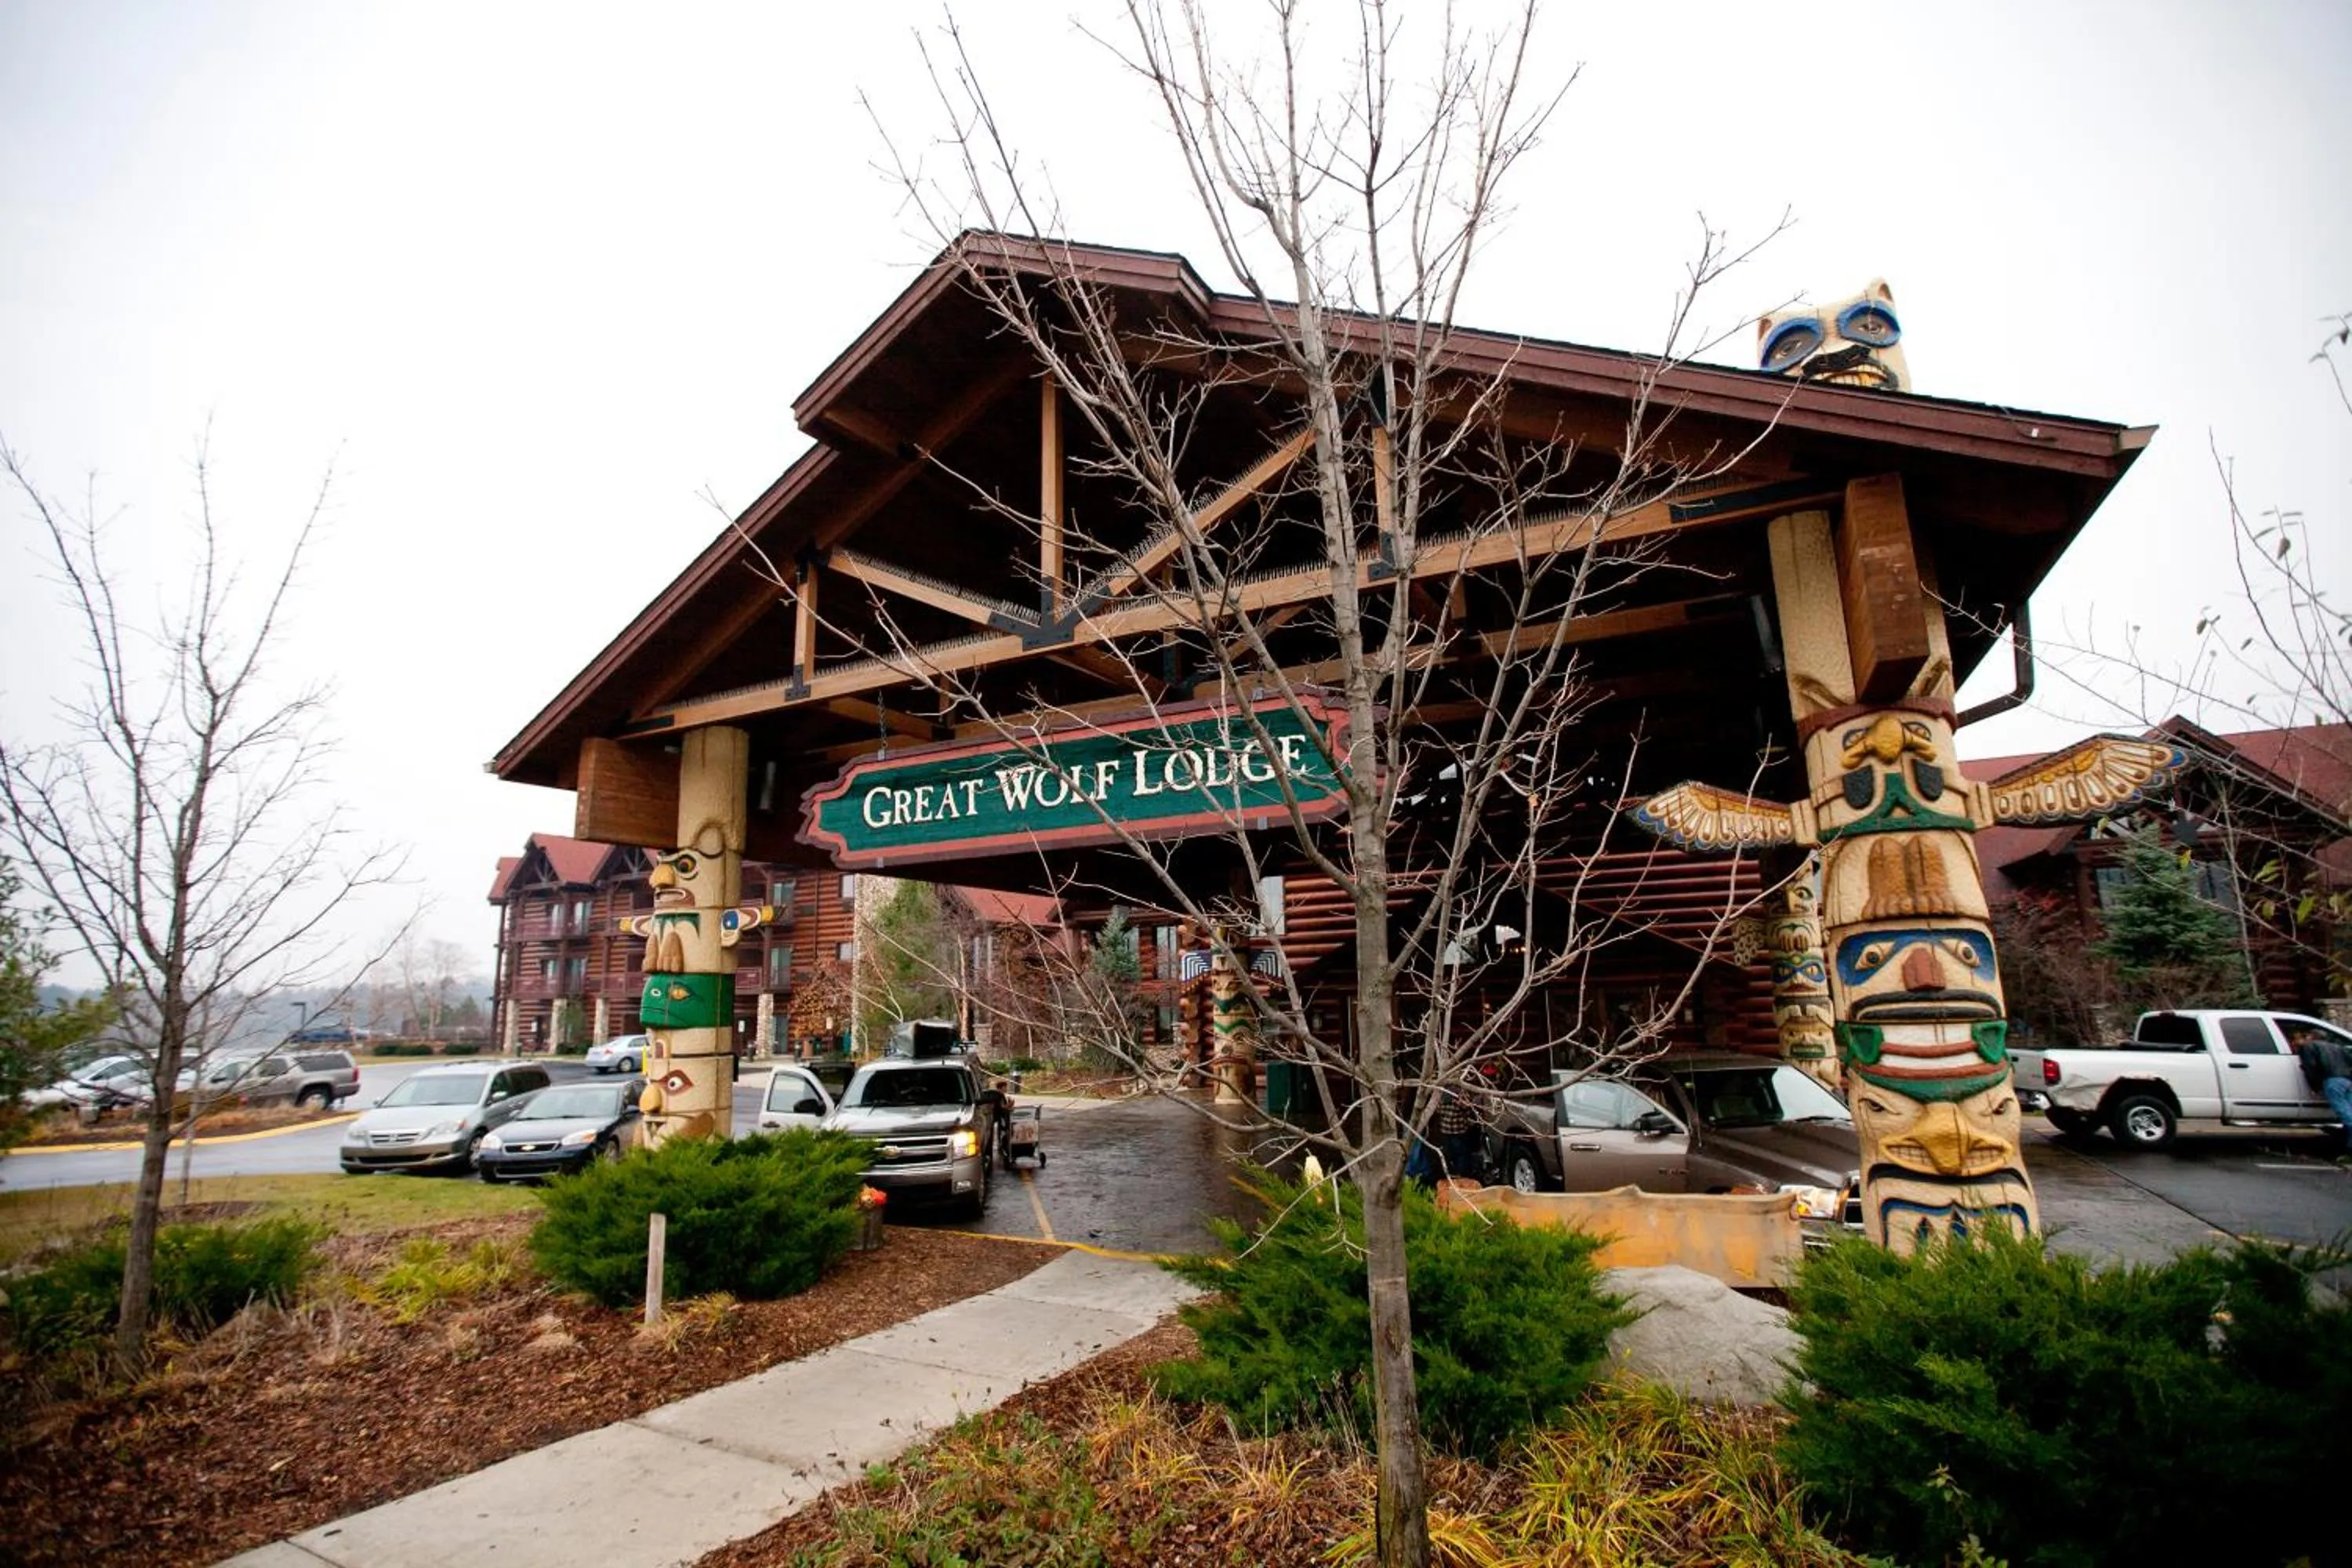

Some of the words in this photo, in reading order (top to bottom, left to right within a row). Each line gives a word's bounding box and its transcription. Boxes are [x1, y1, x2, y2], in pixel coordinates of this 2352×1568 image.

[863, 779, 985, 829] GREAT
[994, 760, 1120, 811] WOLF
[1133, 734, 1306, 797] LODGE
